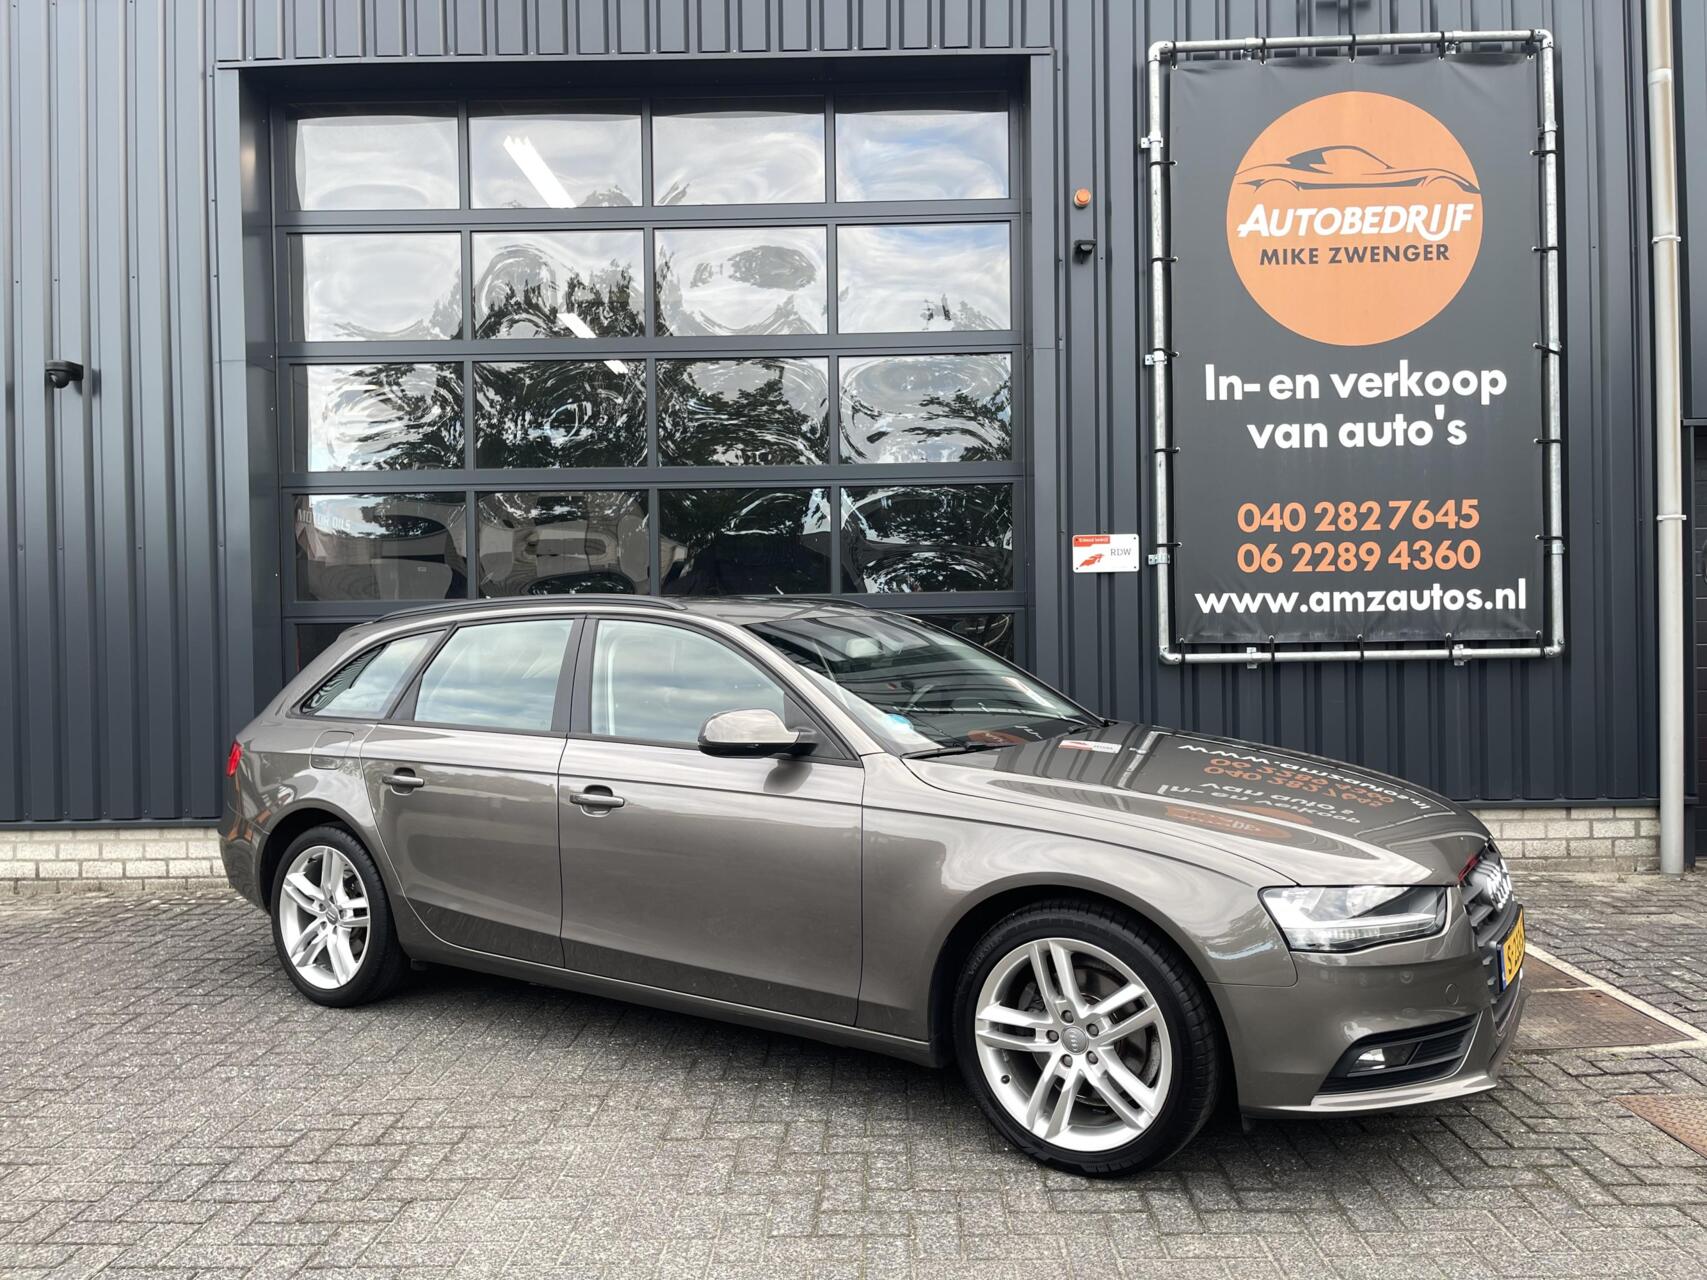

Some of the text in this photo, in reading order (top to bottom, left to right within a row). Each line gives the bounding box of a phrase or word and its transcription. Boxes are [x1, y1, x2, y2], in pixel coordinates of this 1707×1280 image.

[1237, 203, 1475, 241] AUTOBEDRIJF
[1259, 243, 1450, 266] MIKE ZWENGER
[1204, 359, 1508, 406] In- en verkoop
[1246, 404, 1468, 450] van auto's
[297, 508, 351, 531] MOOR OILS
[1237, 499, 1480, 533] 040 282 7645
[1110, 547, 1131, 556] RDW
[1236, 540, 1481, 574] 06 2289 4360
[1194, 577, 1527, 614] www.amzautos.nl
